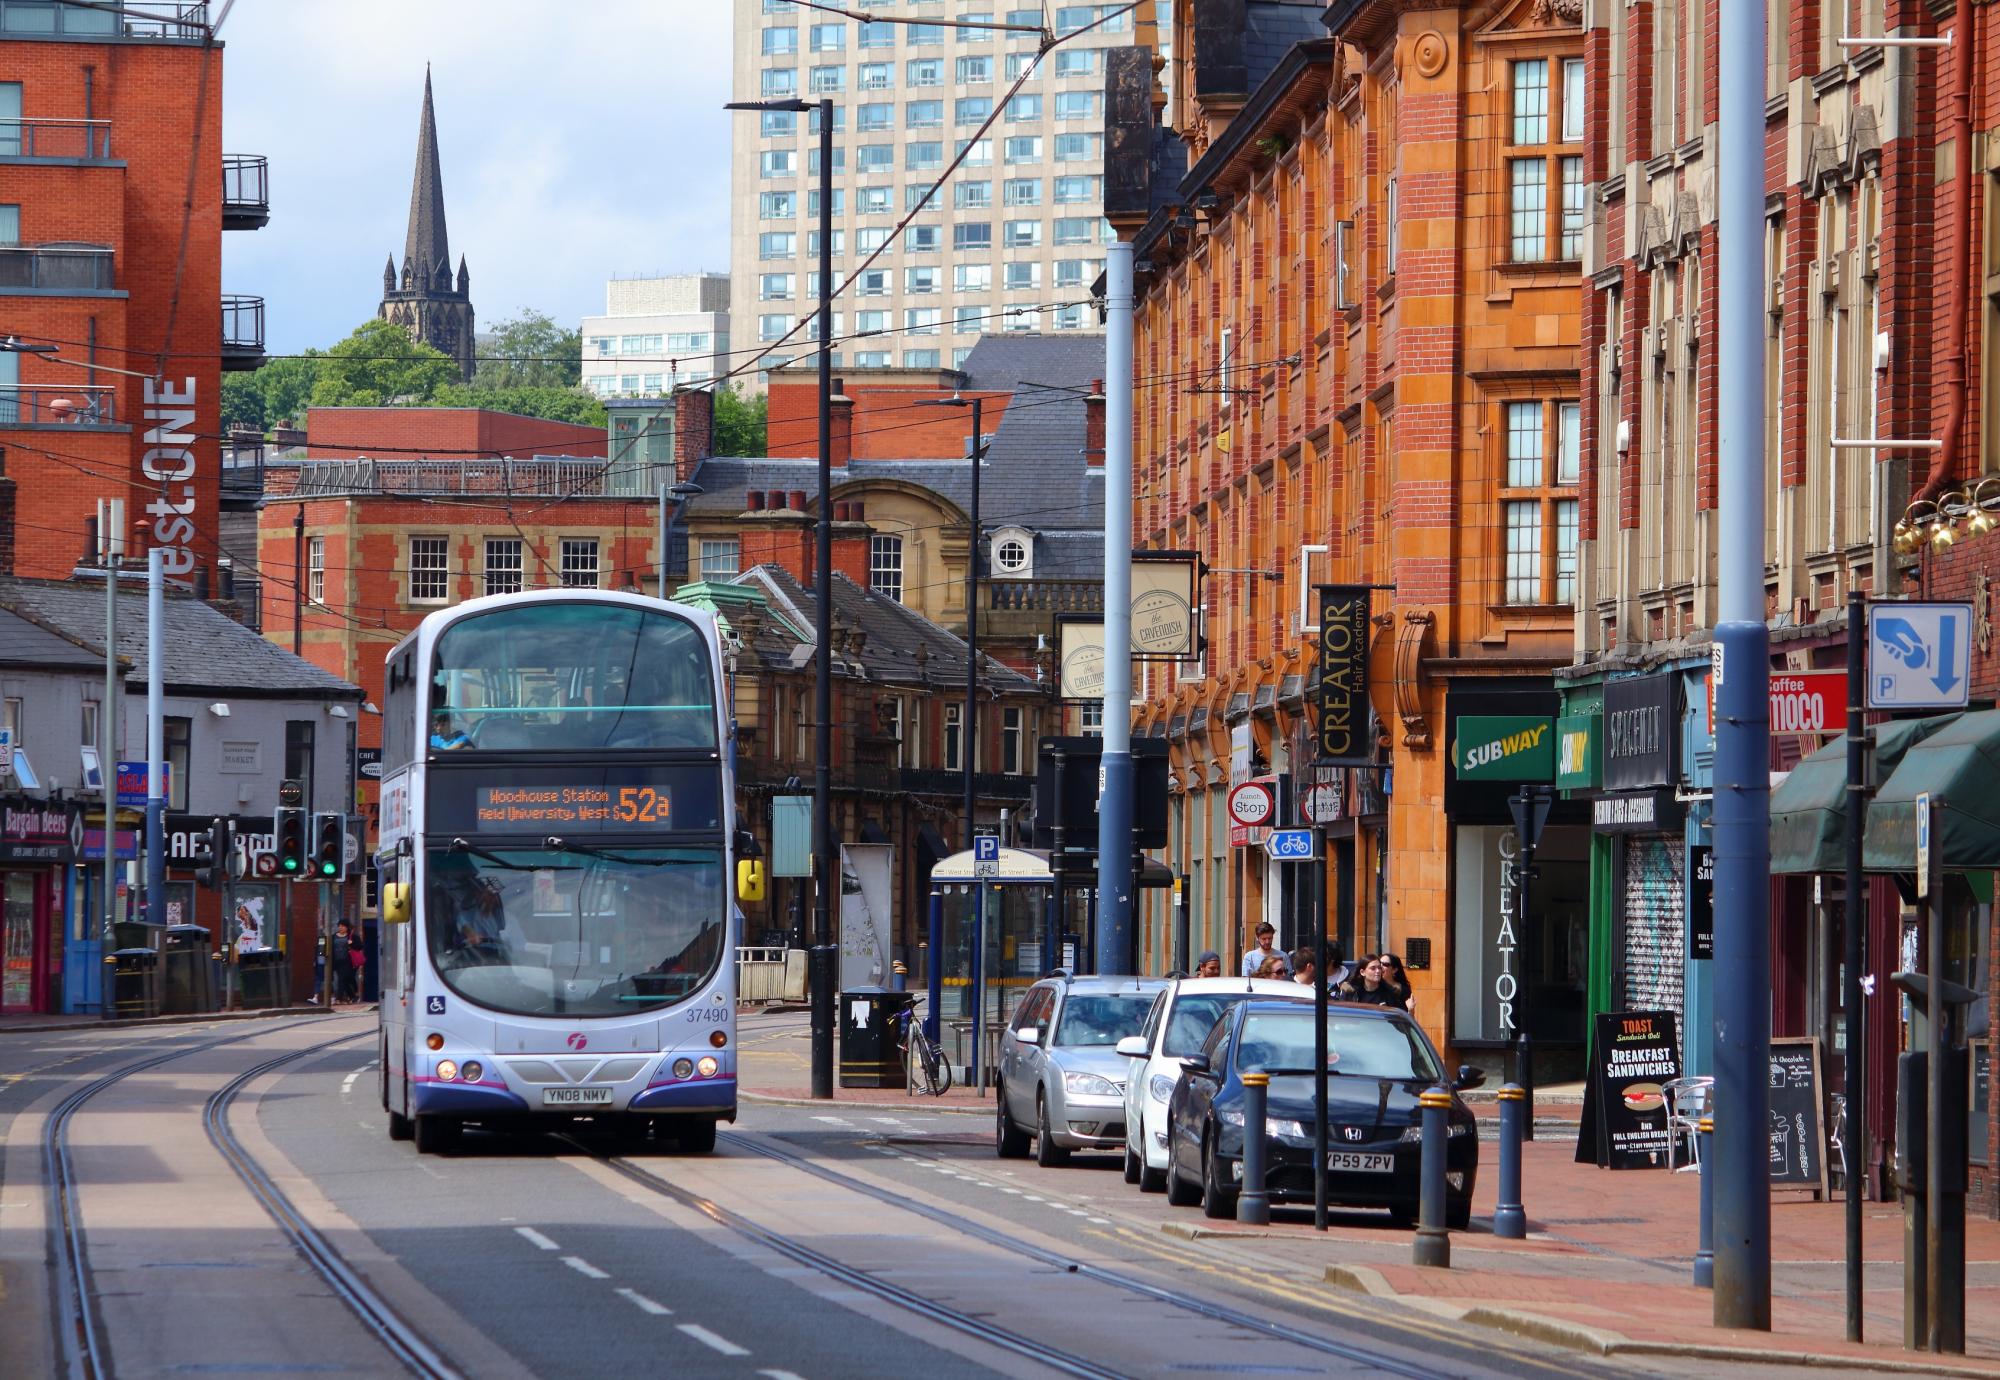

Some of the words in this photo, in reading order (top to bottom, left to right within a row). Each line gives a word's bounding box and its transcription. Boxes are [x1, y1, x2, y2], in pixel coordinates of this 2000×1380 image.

[142, 377, 196, 592] est.ONE
[1139, 621, 1183, 641] CAVENDISH
[1353, 599, 1367, 662] Academy
[1323, 600, 1351, 755] CREATOR
[1353, 665, 1364, 693] Hair
[1880, 677, 1893, 696] P
[1463, 723, 1548, 771] SUBWAY
[489, 789, 559, 804] Woodhouse
[562, 788, 609, 804] Station
[619, 787, 670, 822] 52a
[1235, 801, 1267, 816] Stop
[6, 808, 39, 839] Bargain
[42, 811, 67, 833] Beers
[981, 839, 995, 859] P
[1495, 832, 1517, 1030] CREATOR
[686, 1008, 728, 1022] 37490
[1622, 1019, 1652, 1033] TOAST
[1616, 1034, 1647, 1042] Sandwich
[1612, 1048, 1670, 1064] BREAKFAST
[1607, 1061, 1675, 1078] SANDWICHES
[550, 1090, 580, 1101] YN08
[584, 1090, 606, 1101] NMV
[1627, 1131, 1650, 1140] ENGLISH
[1364, 1156, 1391, 1169] ZPV
